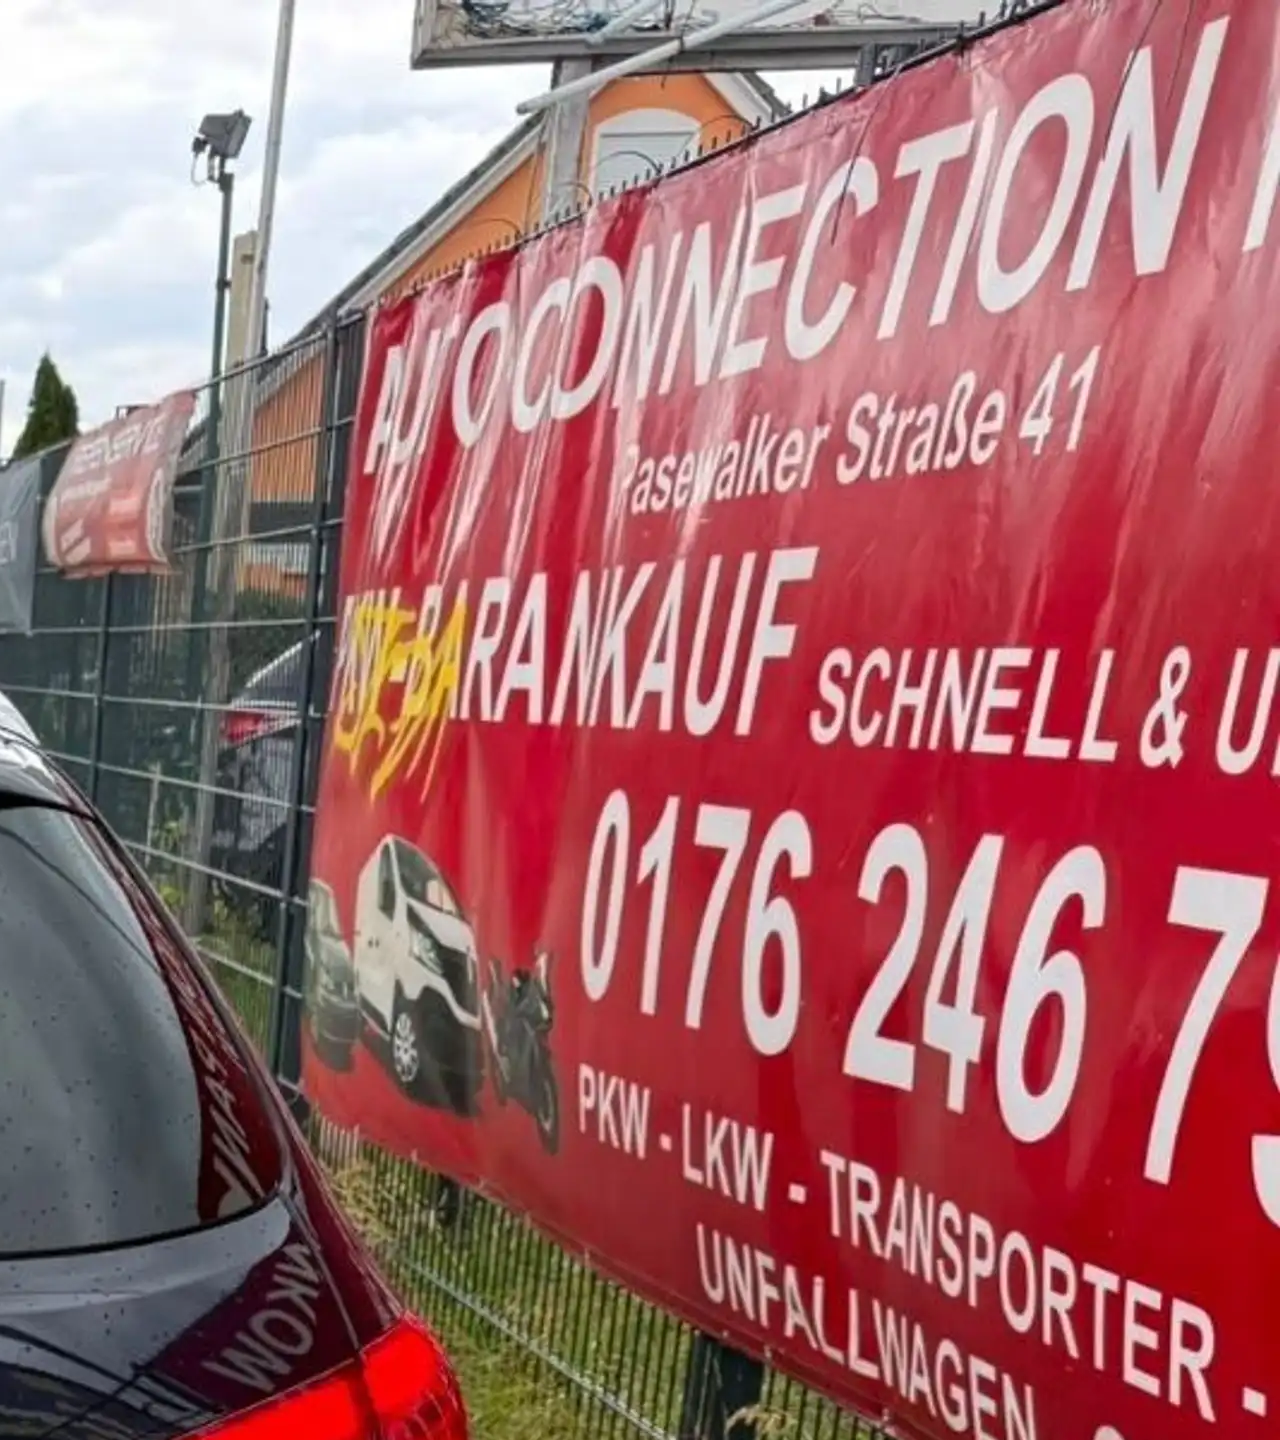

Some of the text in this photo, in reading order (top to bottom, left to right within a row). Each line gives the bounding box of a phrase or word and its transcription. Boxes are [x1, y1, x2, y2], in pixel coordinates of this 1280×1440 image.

[836, 369, 1006, 485] Straße
[1020, 346, 1101, 456] 41
[810, 647, 1119, 762] SCHNELL
[1140, 645, 1191, 769] &
[1215, 648, 1280, 777] U
[580, 788, 812, 1056] 0176
[842, 823, 1107, 1144] 246
[579, 1062, 651, 1160] PKW
[682, 1103, 774, 1211] LKW
[820, 1149, 1216, 1423] TRANSPORTER
